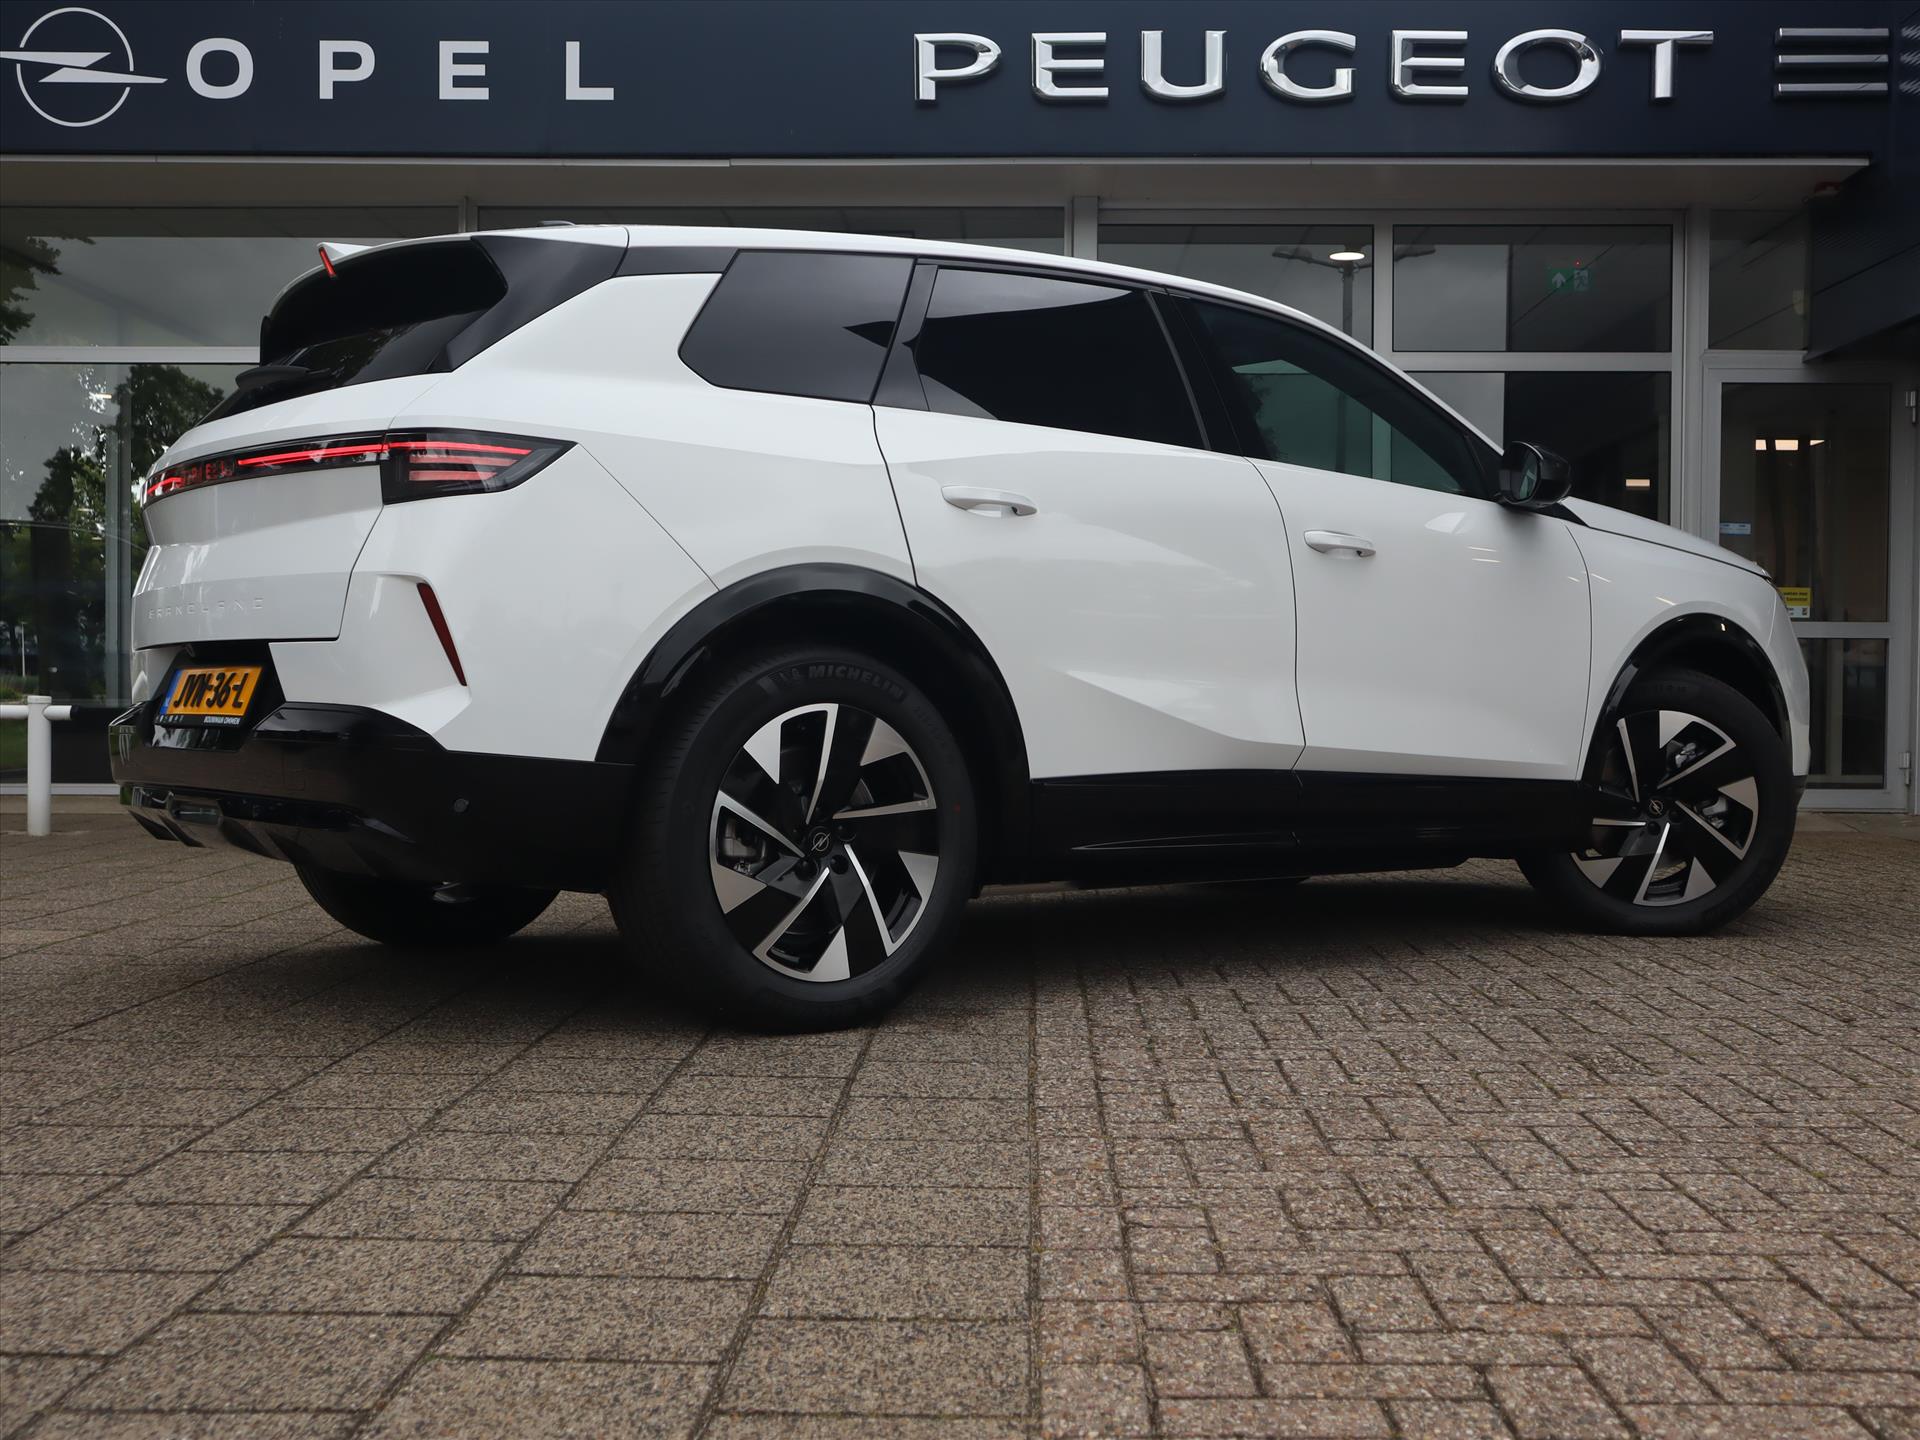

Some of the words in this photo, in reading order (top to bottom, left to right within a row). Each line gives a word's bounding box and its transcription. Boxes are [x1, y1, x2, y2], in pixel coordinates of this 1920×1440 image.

[186, 37, 614, 101] OPEL
[913, 28, 1714, 103] PEUGEOT
[808, 664, 905, 700] MICHELIN
